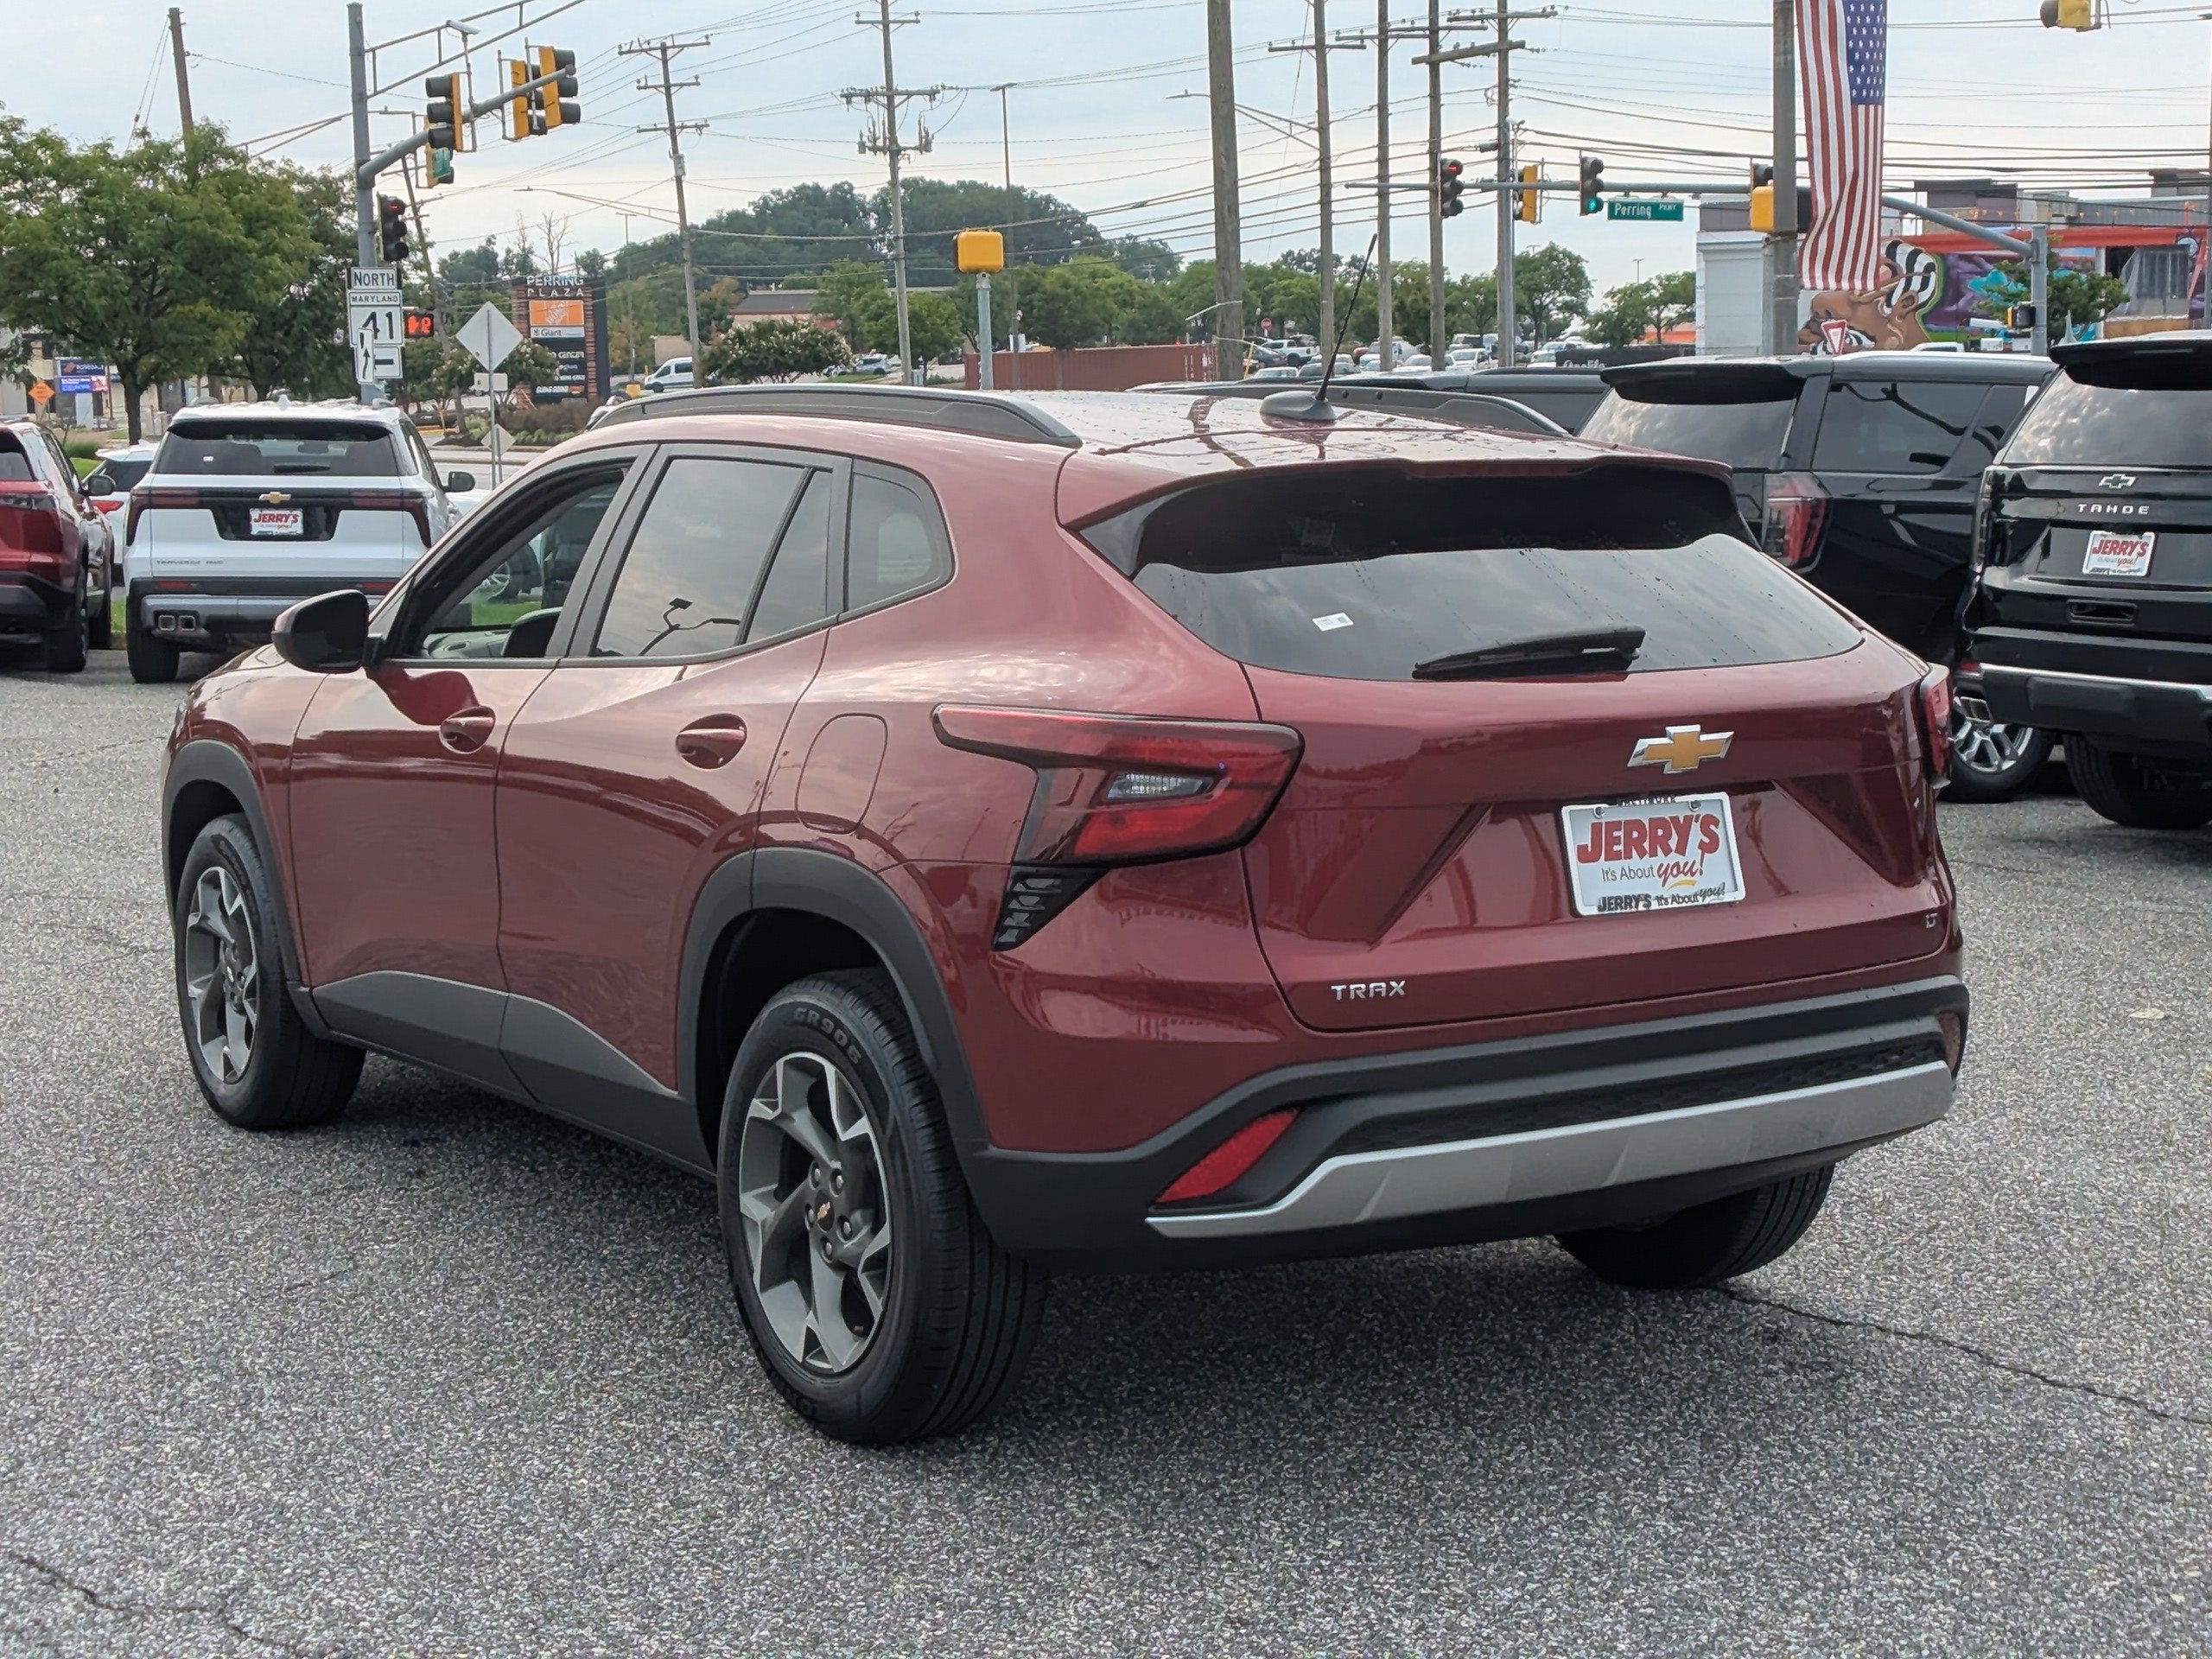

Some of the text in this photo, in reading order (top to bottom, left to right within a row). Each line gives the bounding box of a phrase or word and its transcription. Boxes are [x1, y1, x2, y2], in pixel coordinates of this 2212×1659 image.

[1614, 202, 1651, 219] Perring
[353, 271, 394, 286] NORTH
[526, 276, 583, 286] PERRING
[527, 288, 583, 296] PLAZA
[362, 311, 394, 340] 41
[253, 513, 299, 524] JERRY'S
[2078, 504, 2149, 515] TAHOE
[2092, 538, 2149, 557] JERRY'S
[1577, 813, 1720, 864] JERRY'S
[1602, 850, 1705, 888] It's About you!
[1598, 893, 1652, 912] JERRY'S
[1670, 891, 1700, 906] About
[1331, 980, 1406, 1001] TRAX
